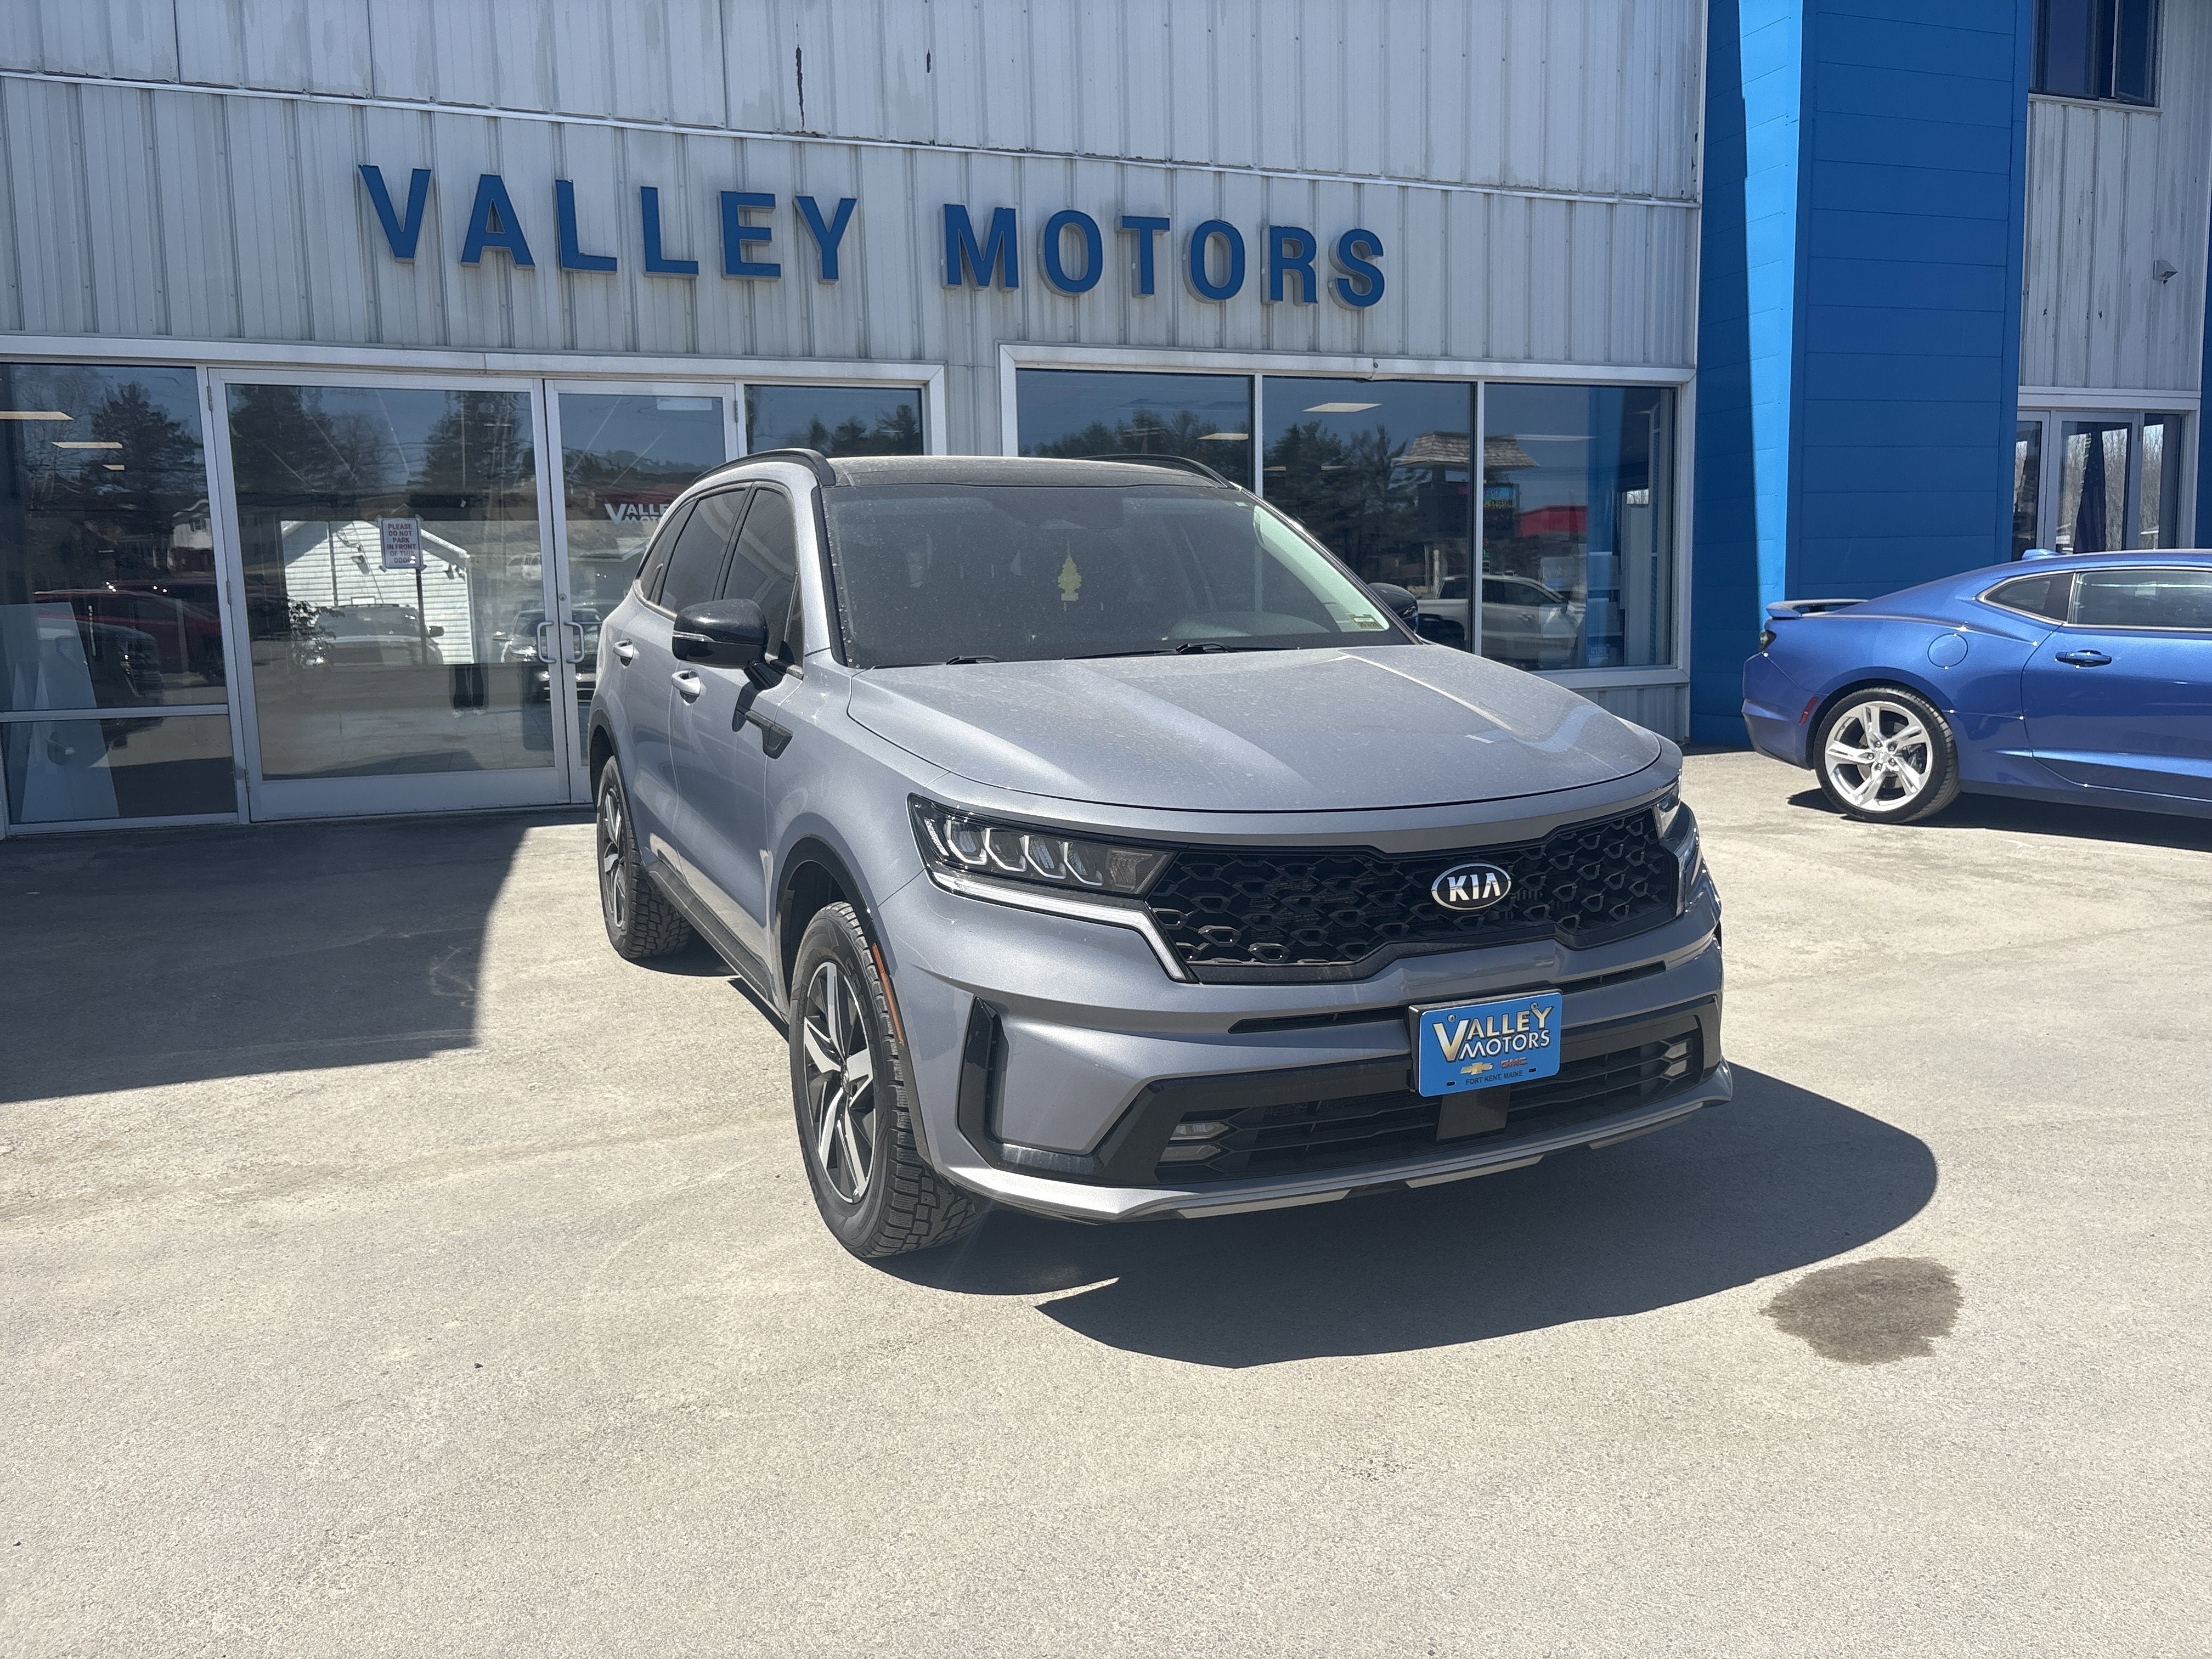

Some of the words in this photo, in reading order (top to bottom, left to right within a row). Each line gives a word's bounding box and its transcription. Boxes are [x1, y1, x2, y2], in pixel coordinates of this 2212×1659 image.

[358, 164, 857, 284] VALLEY
[940, 204, 1385, 310] MOTORS
[604, 503, 670, 526] VALLE
[1447, 872, 1500, 902] KIA
[1432, 1006, 1554, 1063] VALLEY
[1457, 1029, 1551, 1061] MOTORS
[1500, 1057, 1528, 1068] GMC
[1465, 1077, 1483, 1086] FORT
[1503, 1070, 1523, 1080] MAINE
